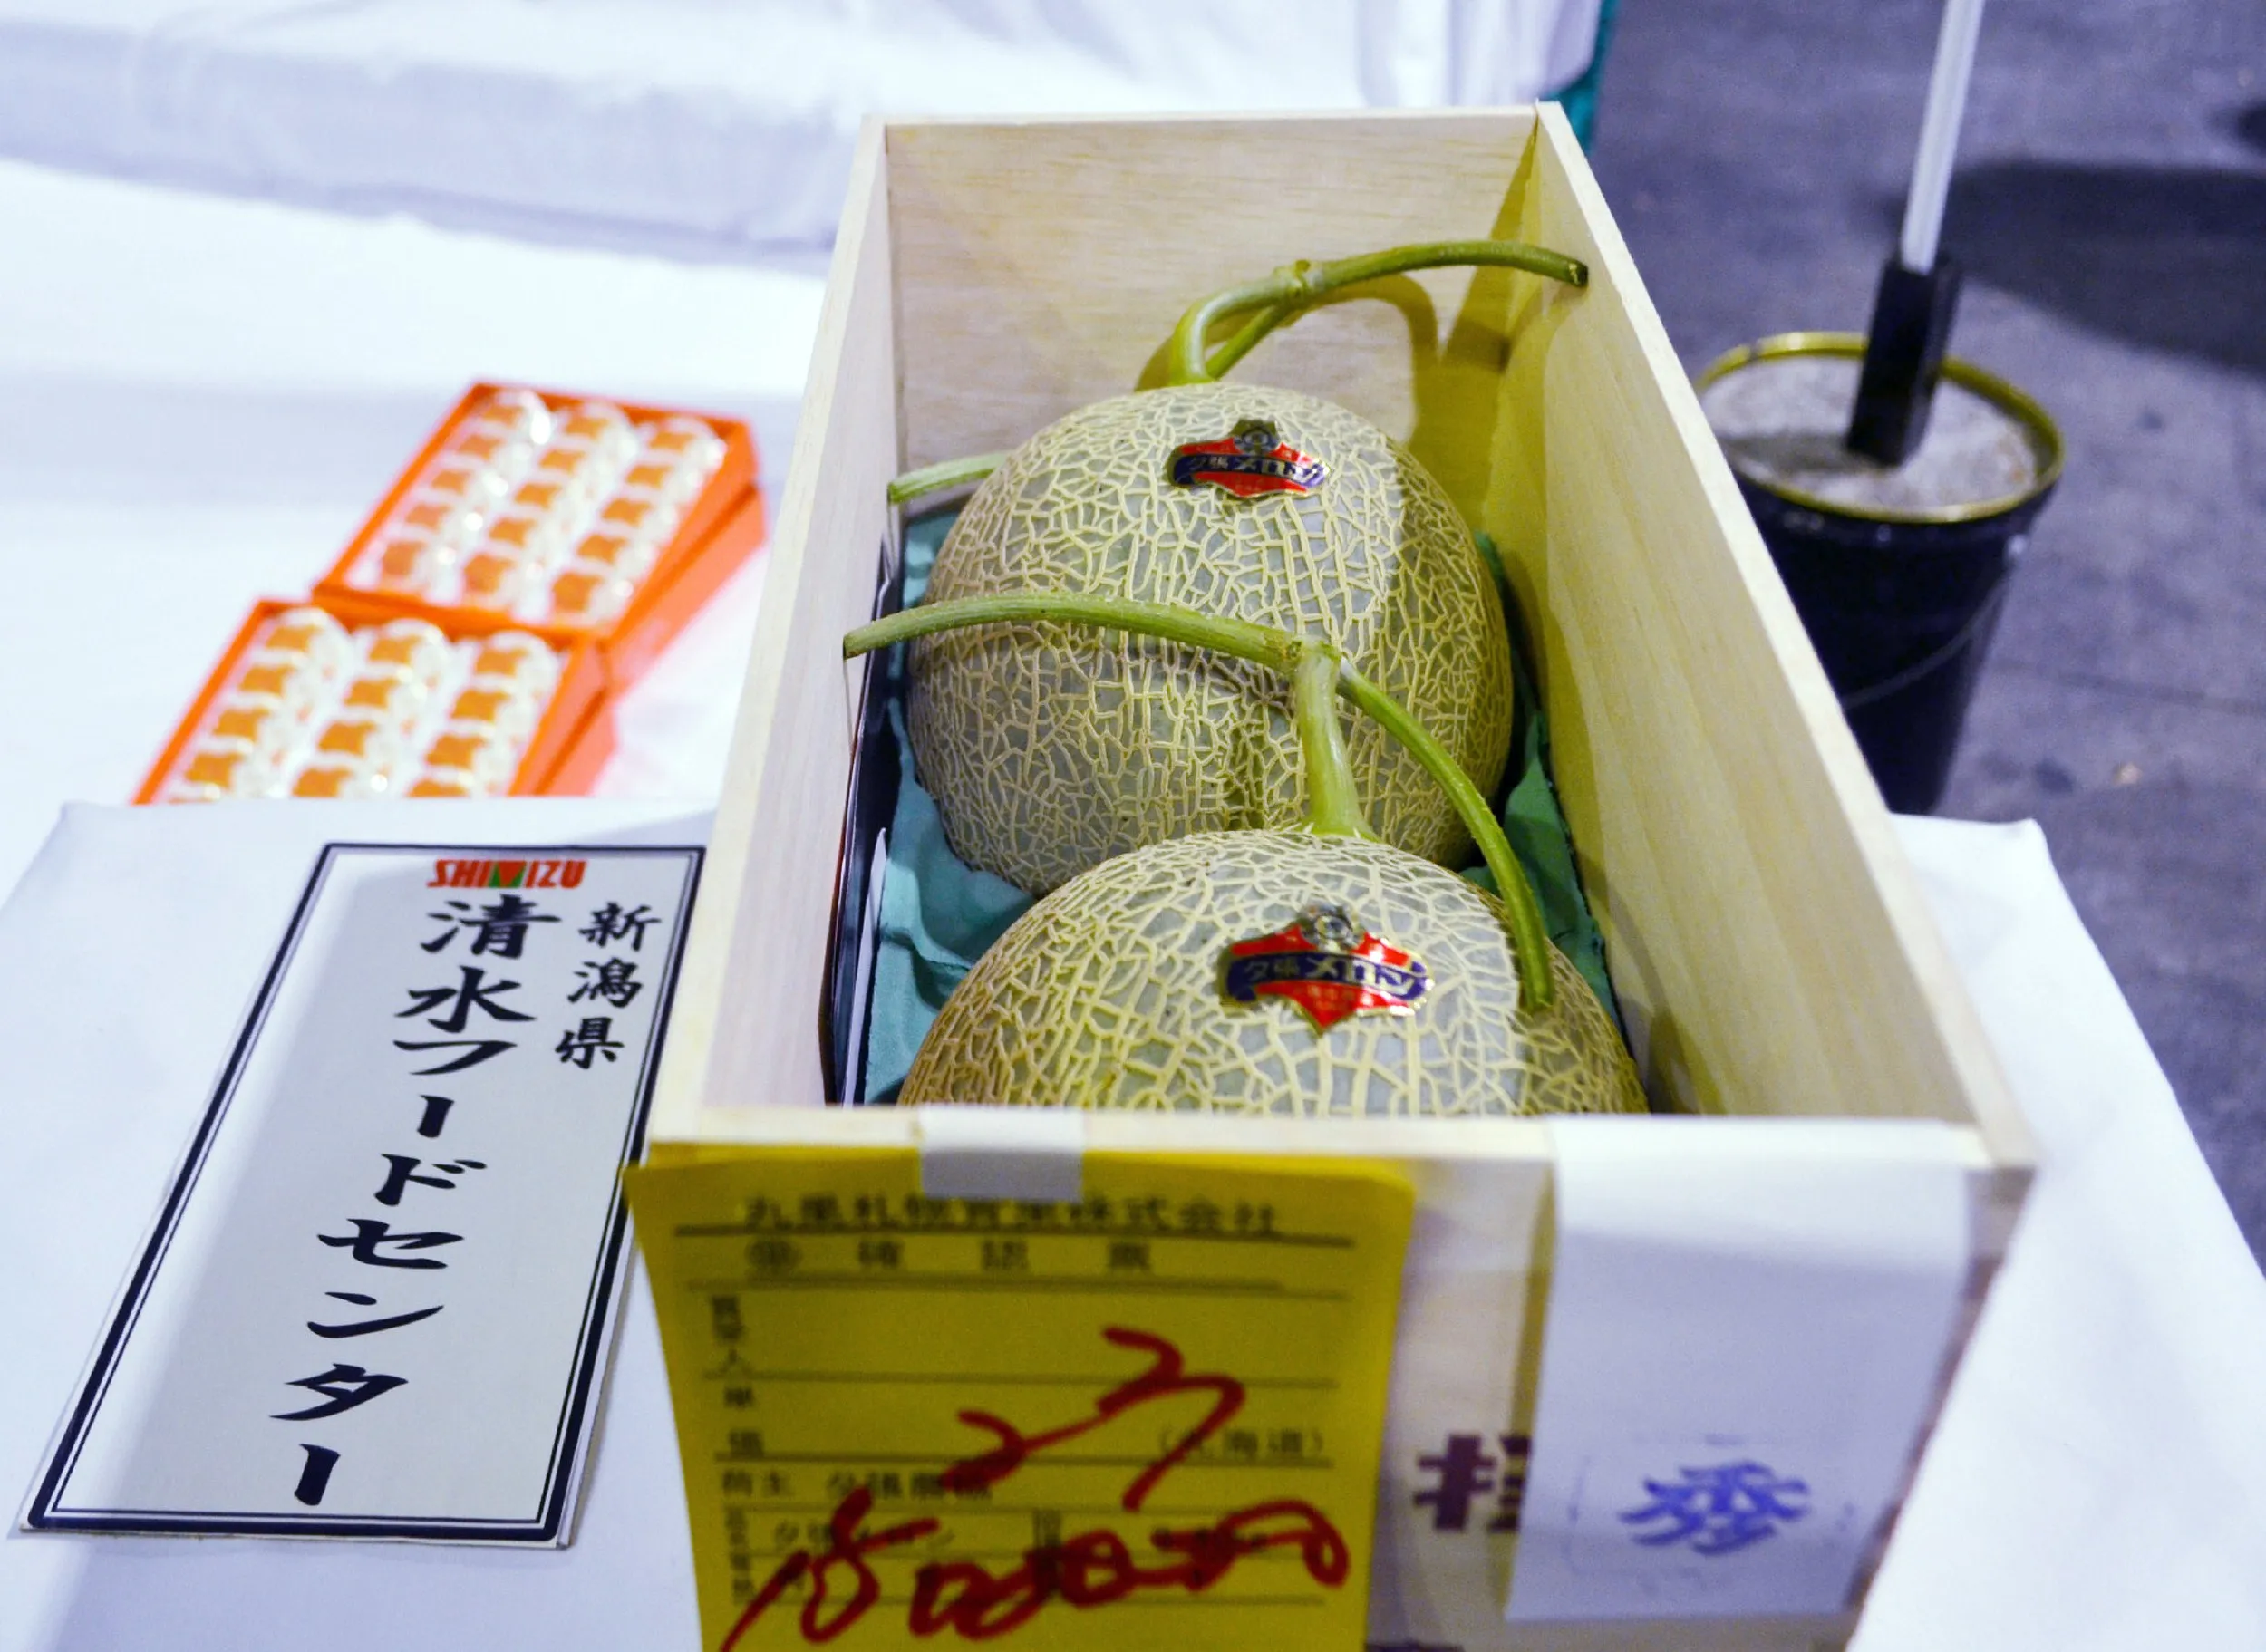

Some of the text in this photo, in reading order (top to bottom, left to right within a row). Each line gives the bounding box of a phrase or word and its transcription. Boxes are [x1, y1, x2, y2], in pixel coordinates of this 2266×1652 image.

[425, 858, 588, 889] SHIMIZU
[554, 901, 663, 1069] 新潟県
[268, 894, 562, 1507] 清水フードセンター
